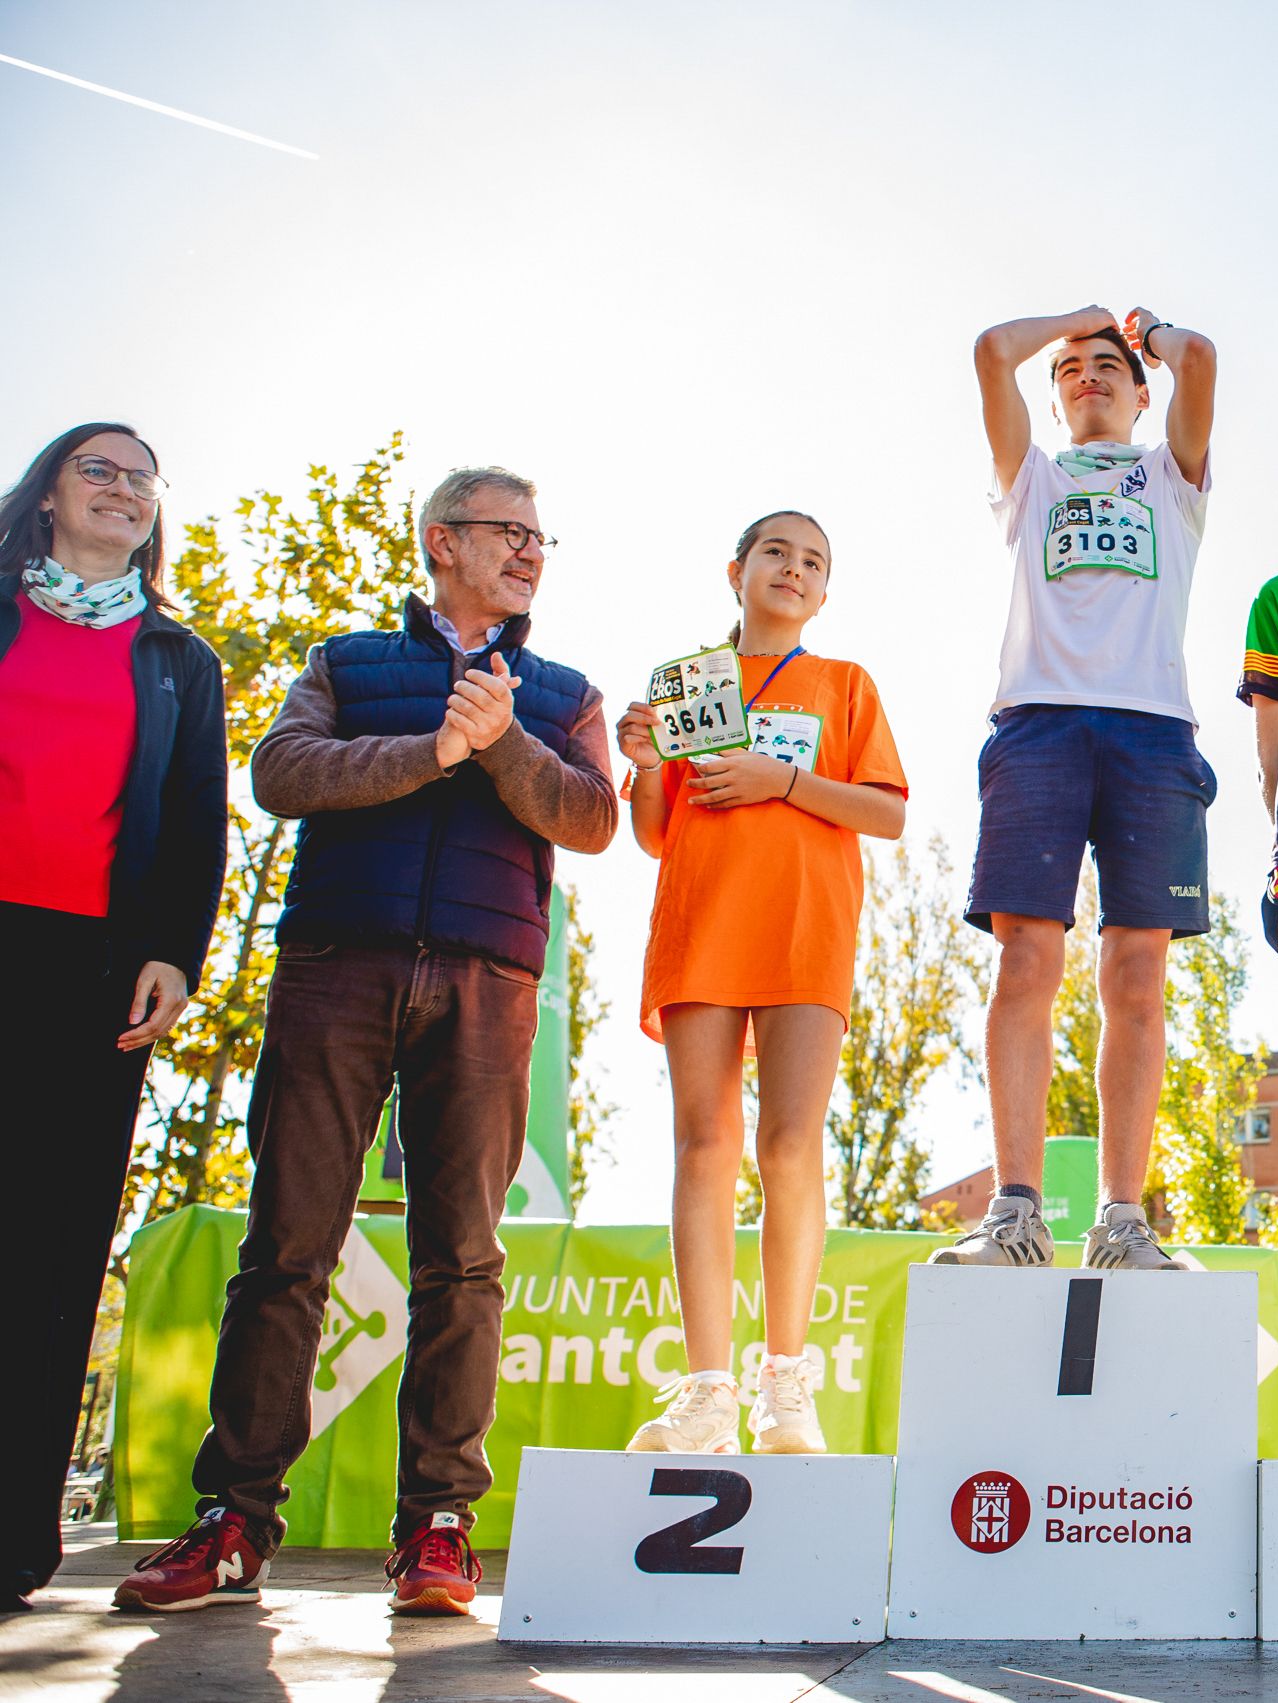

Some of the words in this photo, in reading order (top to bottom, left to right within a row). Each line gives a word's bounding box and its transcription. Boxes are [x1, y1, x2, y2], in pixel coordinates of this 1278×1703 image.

[1058, 533, 1138, 555] 3103
[651, 679, 682, 700] CROS
[664, 702, 727, 736] 3641
[502, 1275, 762, 1322] JUNTAMN
[1046, 1485, 1193, 1514] Diputació
[634, 1468, 752, 1575] 2
[1045, 1519, 1192, 1544] Barcelona
